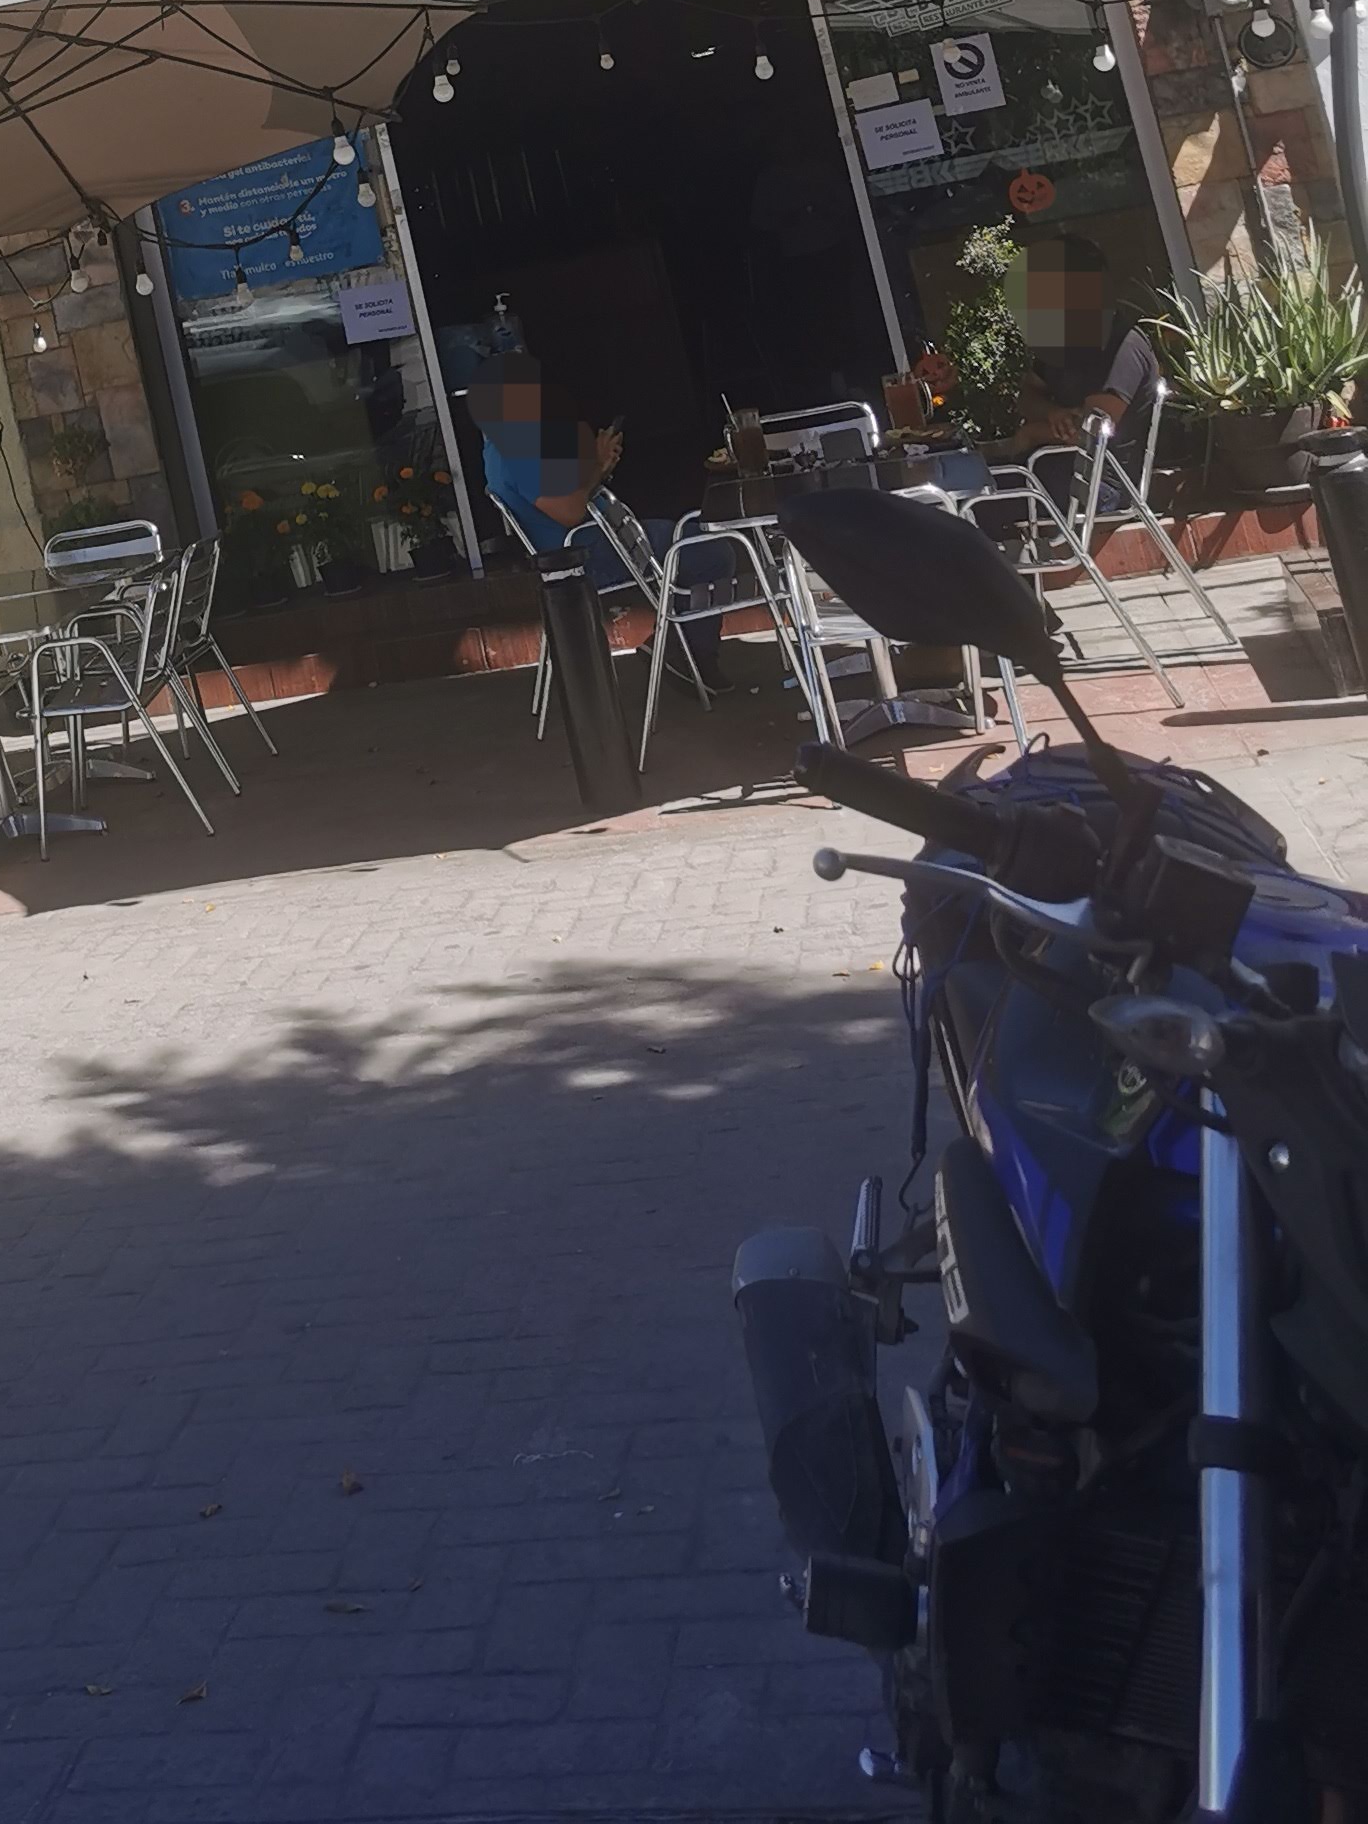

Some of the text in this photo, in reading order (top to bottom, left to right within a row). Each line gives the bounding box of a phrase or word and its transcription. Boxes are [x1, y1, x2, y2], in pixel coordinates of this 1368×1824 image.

[885, 118, 917, 132] SOLICITA
[879, 128, 918, 142] PERSONAL
[220, 261, 277, 281] Tlamulco
